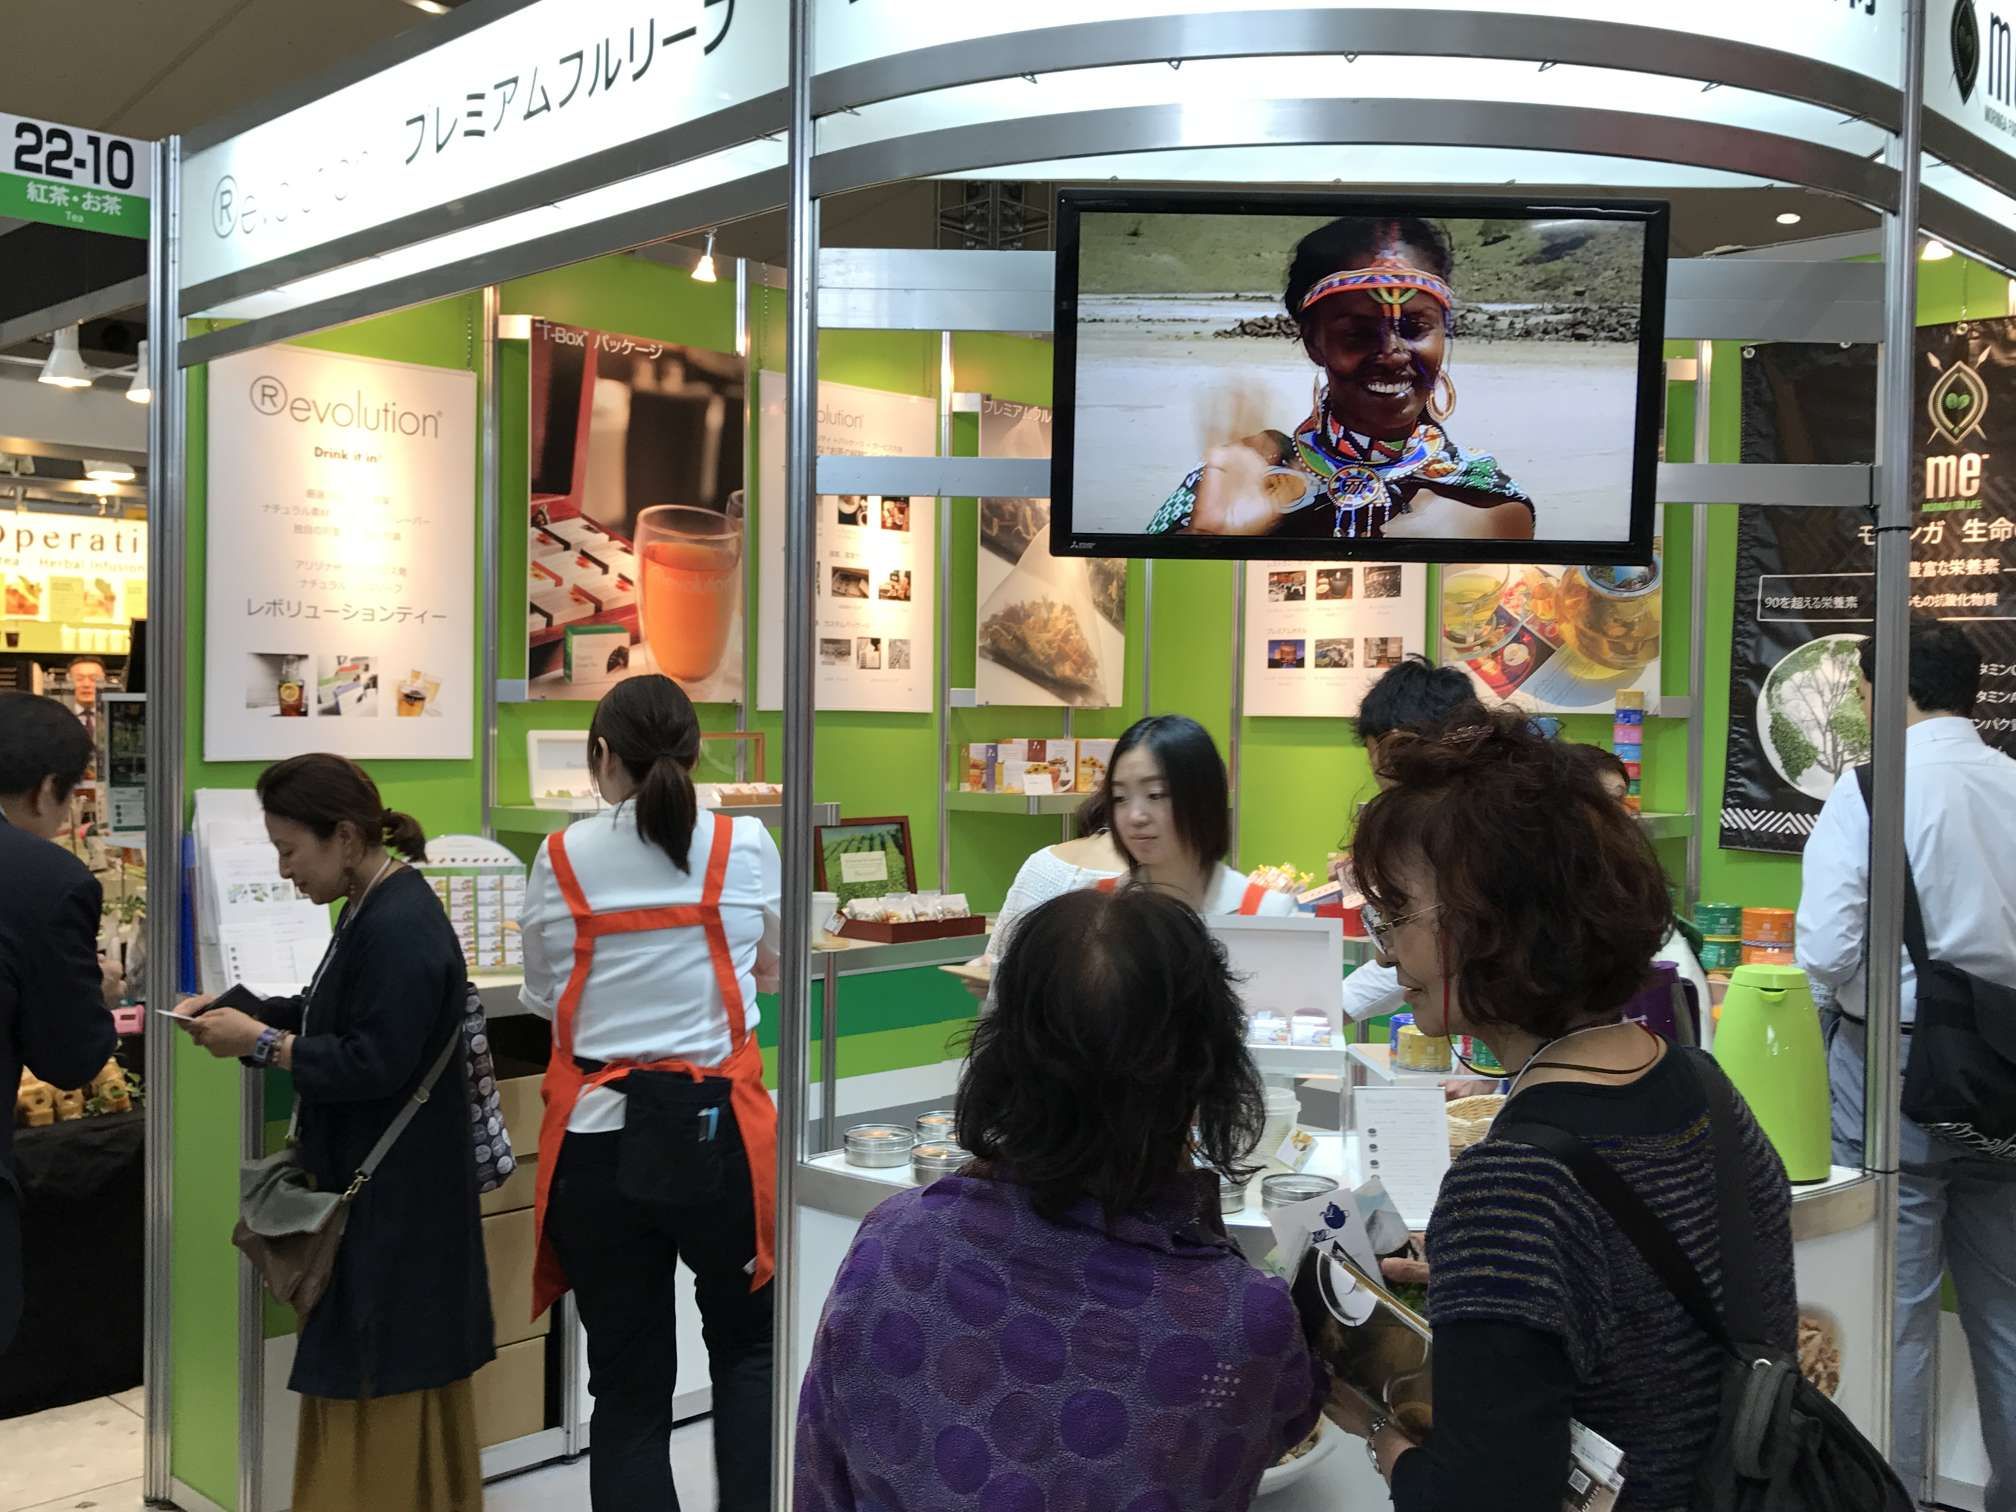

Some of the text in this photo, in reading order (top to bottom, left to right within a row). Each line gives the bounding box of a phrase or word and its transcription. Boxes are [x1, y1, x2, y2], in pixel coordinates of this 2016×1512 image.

[14, 121, 134, 190] 22-10
[26, 181, 122, 216] 紅茶・お茶
[64, 211, 85, 223] Tea
[594, 334, 663, 359] パッケージ
[816, 403, 863, 429] olution
[314, 446, 348, 460] Drink
[1961, 516, 2016, 543] 生命
